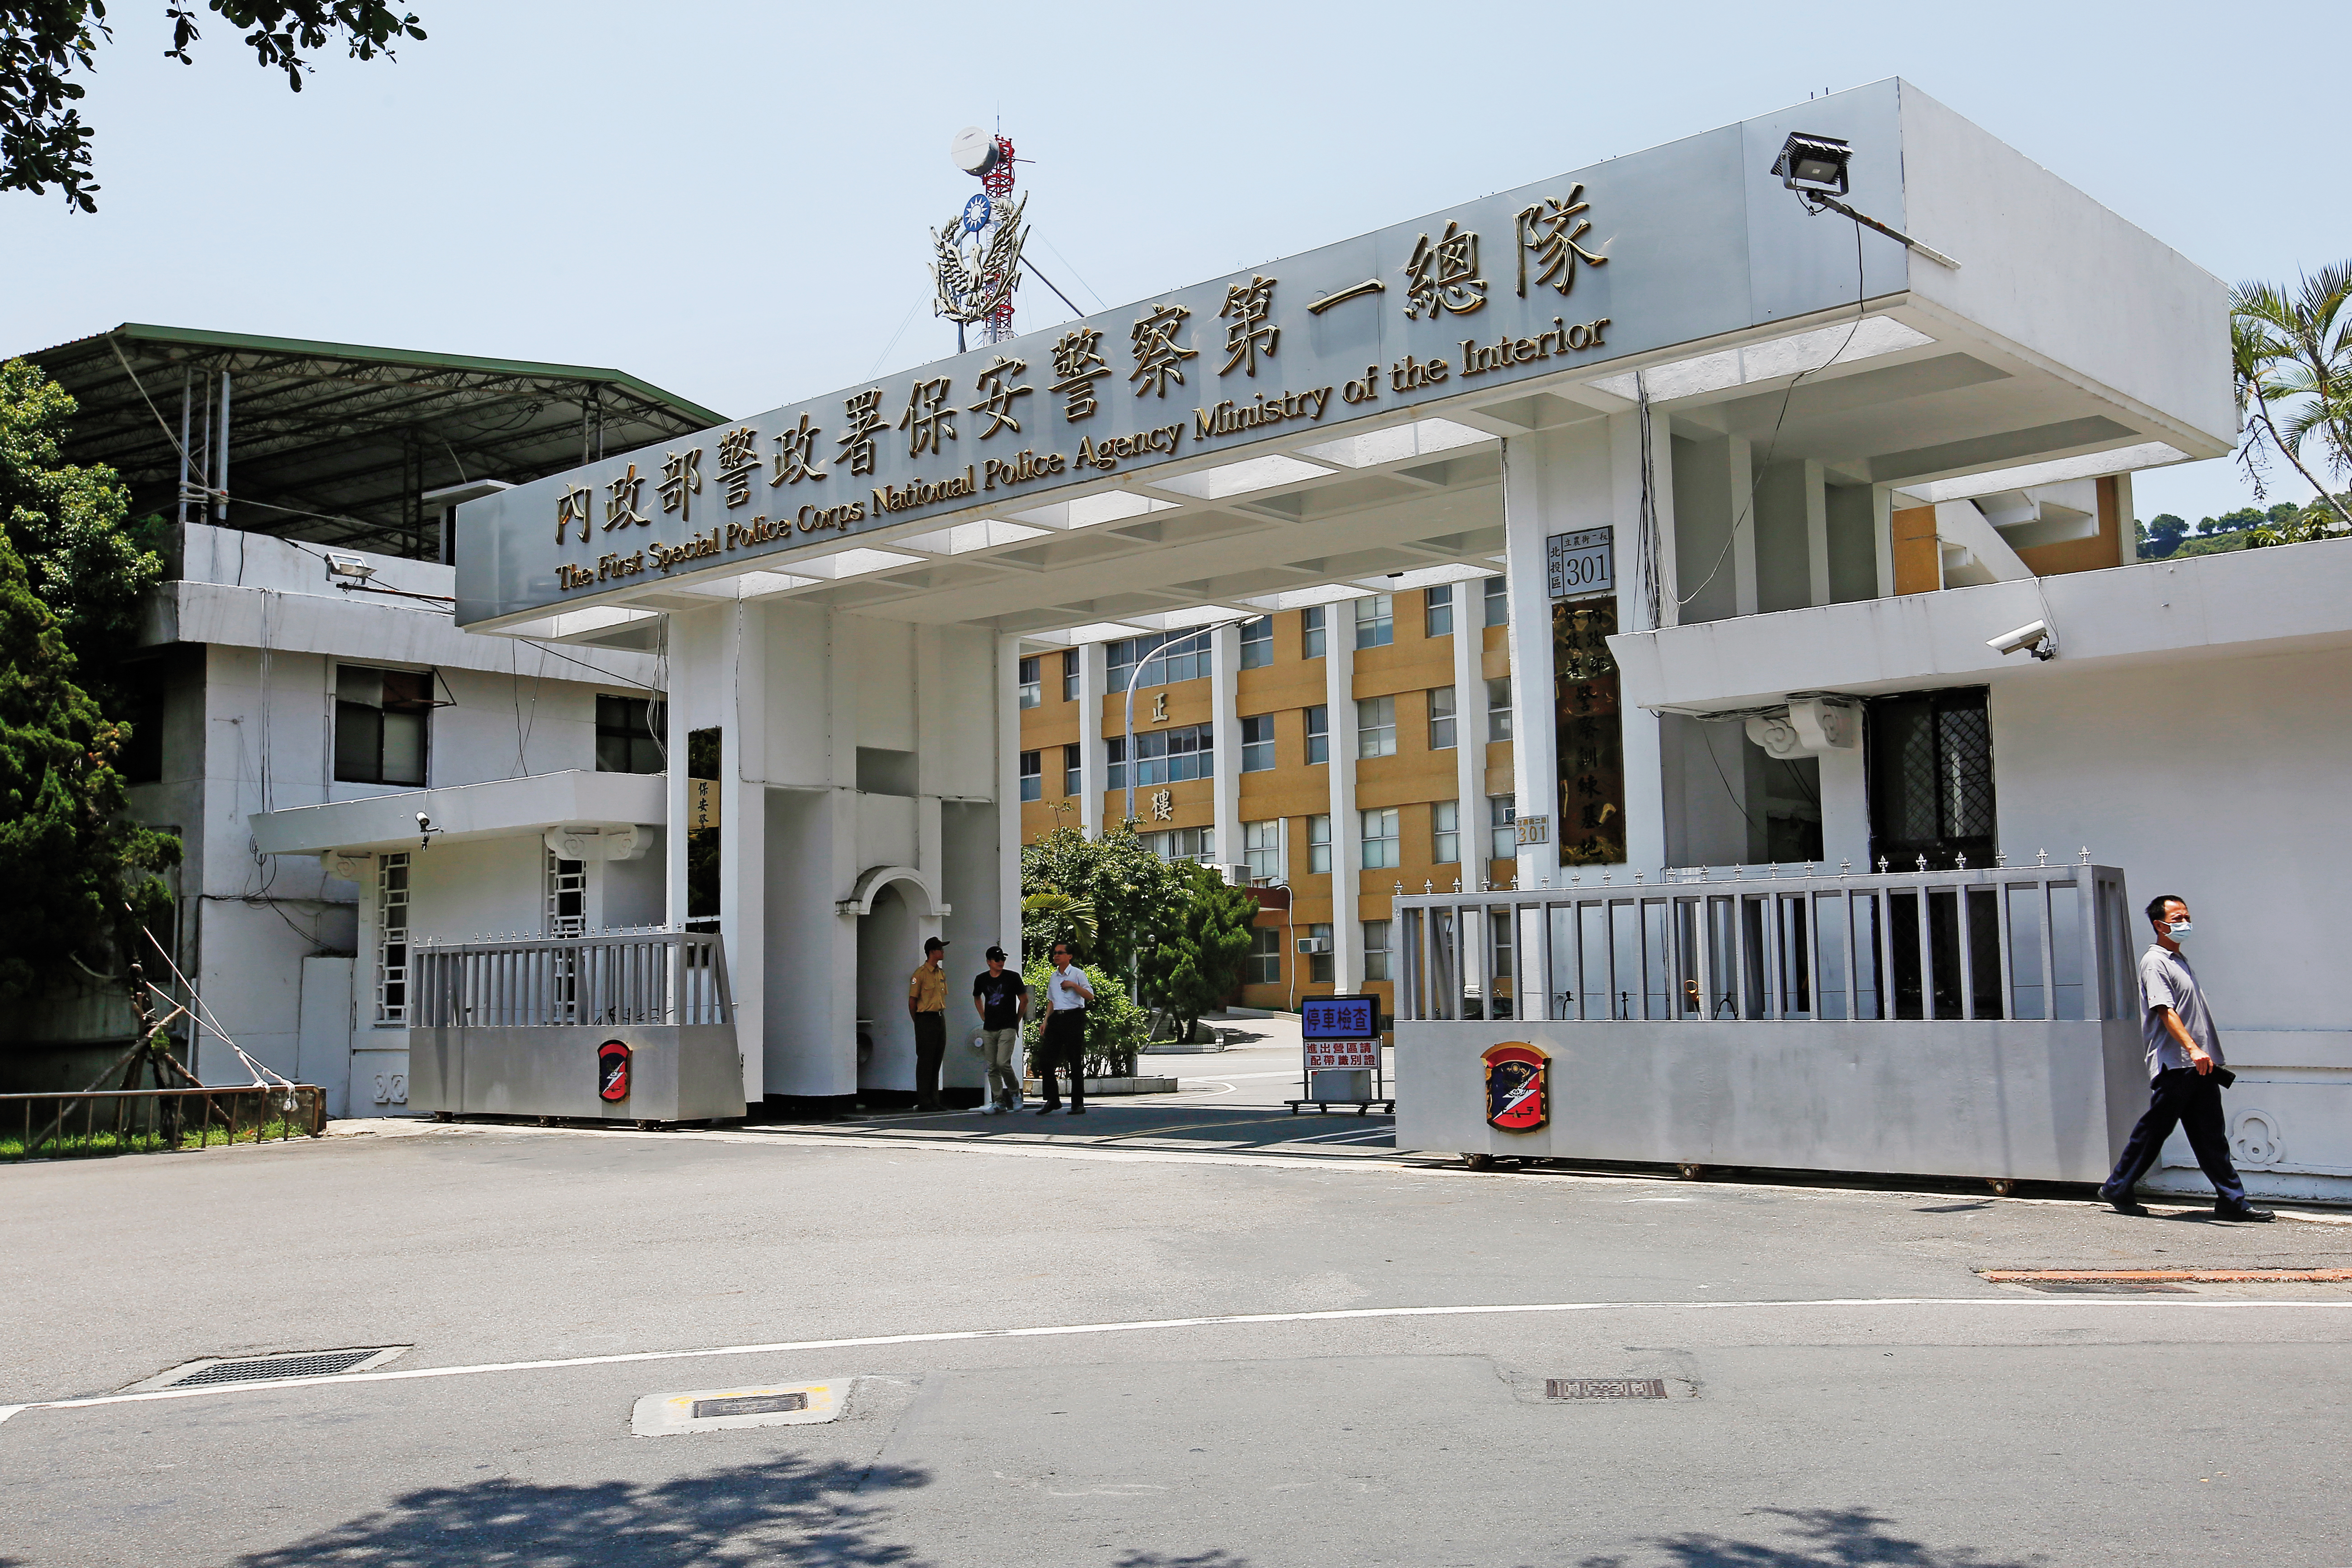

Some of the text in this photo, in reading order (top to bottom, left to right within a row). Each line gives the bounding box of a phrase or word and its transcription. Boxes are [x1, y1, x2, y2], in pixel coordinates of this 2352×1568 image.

[555, 181, 1608, 545] 內政部警政署保安警察第一總隊
[555, 316, 1611, 591] The First Special Police Corps National Police Agency Ministry of the Interior
[1564, 532, 1608, 548] 立農街二段
[1550, 546, 1562, 589] 北投區
[1567, 554, 1608, 586] 301
[1519, 825, 1545, 842] 301
[1306, 1006, 1368, 1031] 停車檢查
[1307, 1043, 1371, 1054] 進出營區請
[1310, 1054, 1376, 1066] 配帶識別證
